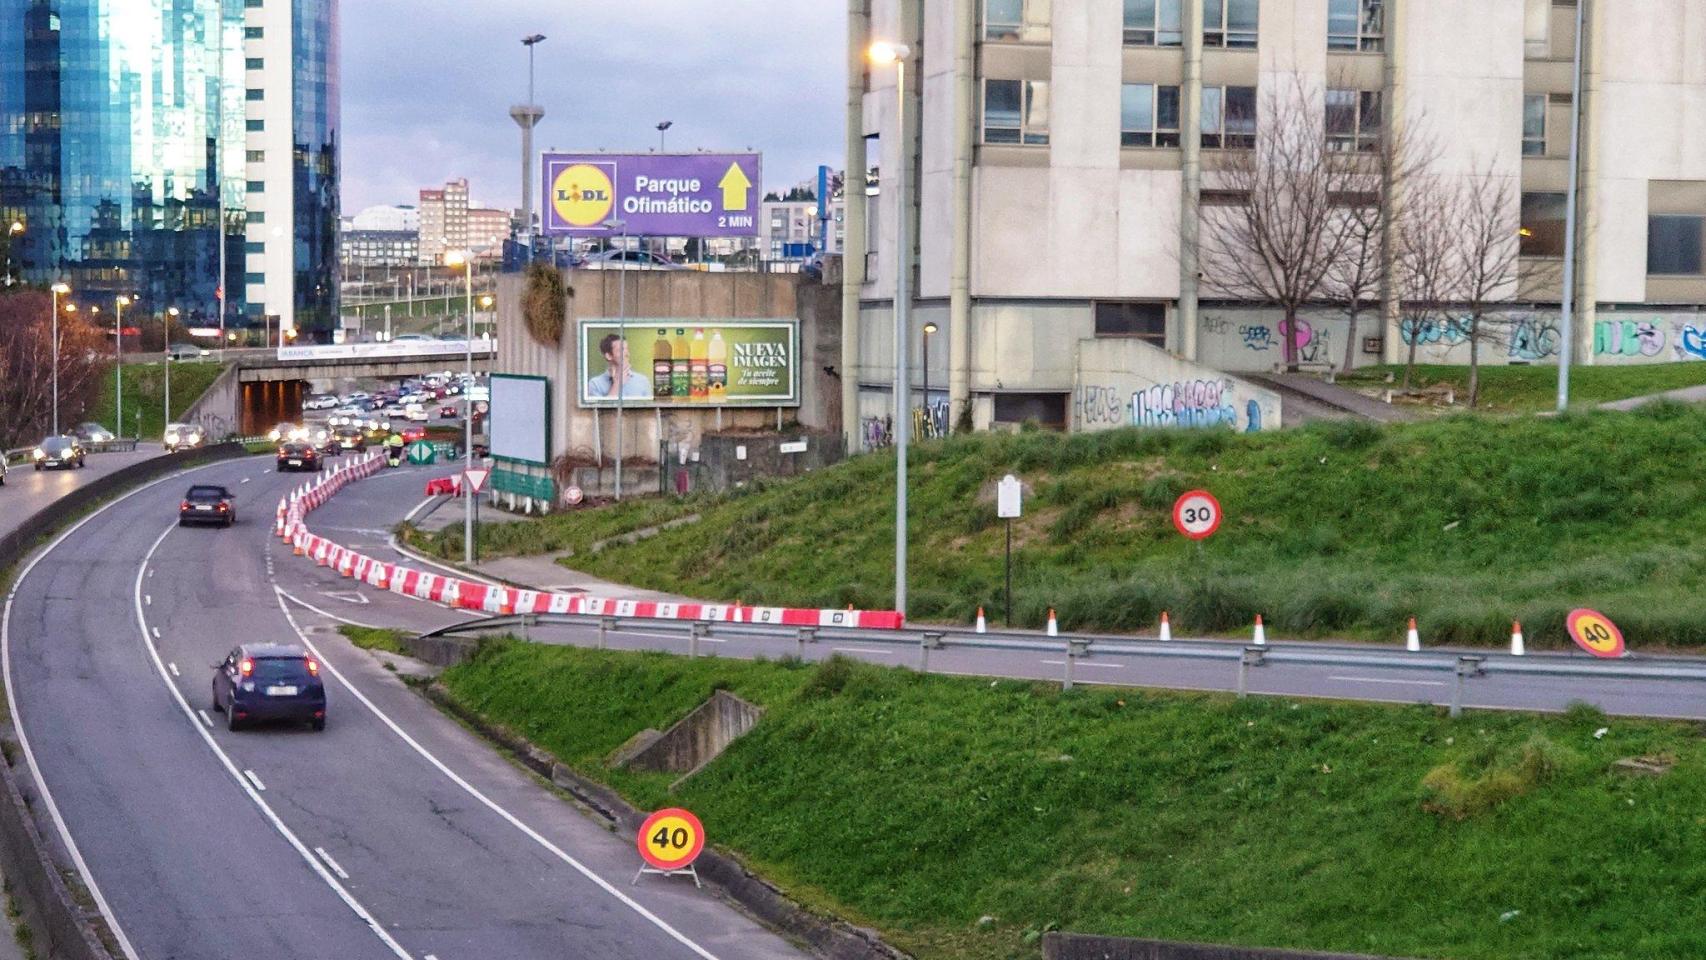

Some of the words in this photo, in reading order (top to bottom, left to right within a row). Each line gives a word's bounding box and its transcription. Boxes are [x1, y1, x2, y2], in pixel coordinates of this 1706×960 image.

[635, 176, 701, 197] Parque
[623, 196, 713, 214] Ofimático
[718, 217, 727, 228] 2
[729, 216, 753, 228] MIN
[734, 343, 787, 356] NUEVA
[733, 356, 787, 367] IMAGEN
[1185, 507, 1210, 523] 30
[1584, 624, 1610, 643] 40
[652, 827, 689, 849] 40
